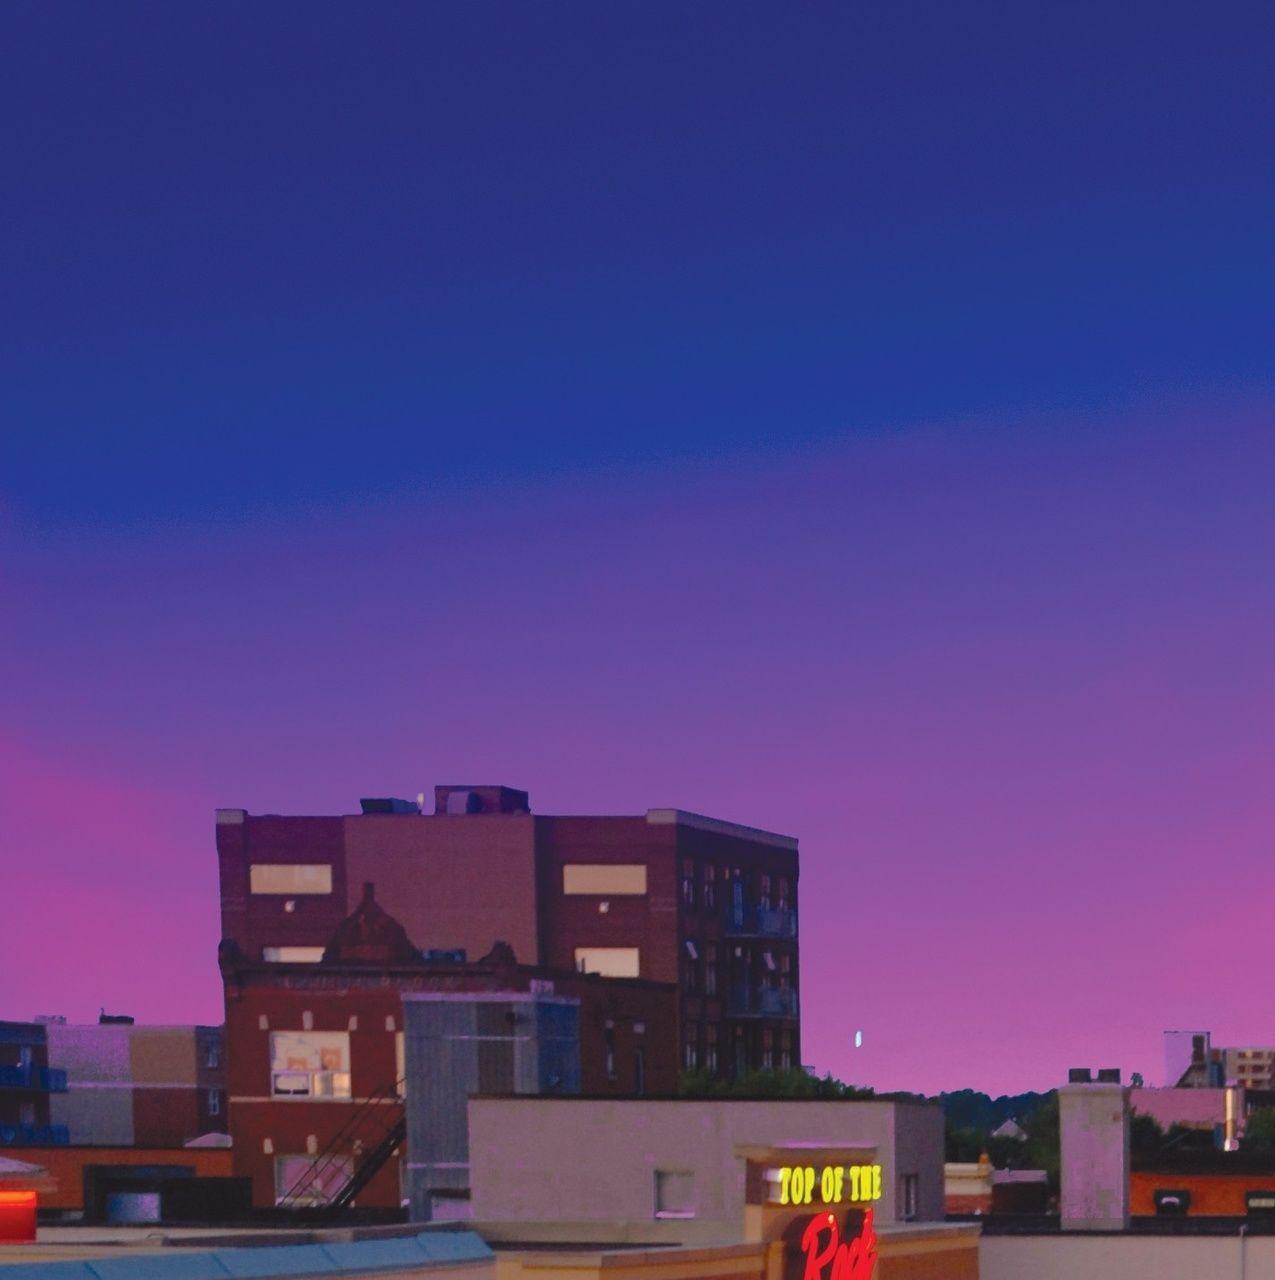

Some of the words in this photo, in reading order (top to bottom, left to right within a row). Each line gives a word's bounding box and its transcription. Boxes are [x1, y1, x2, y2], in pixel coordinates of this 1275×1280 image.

[779, 1166, 815, 1205] TOP
[821, 1166, 844, 1203] OF
[850, 1164, 882, 1201] THE
